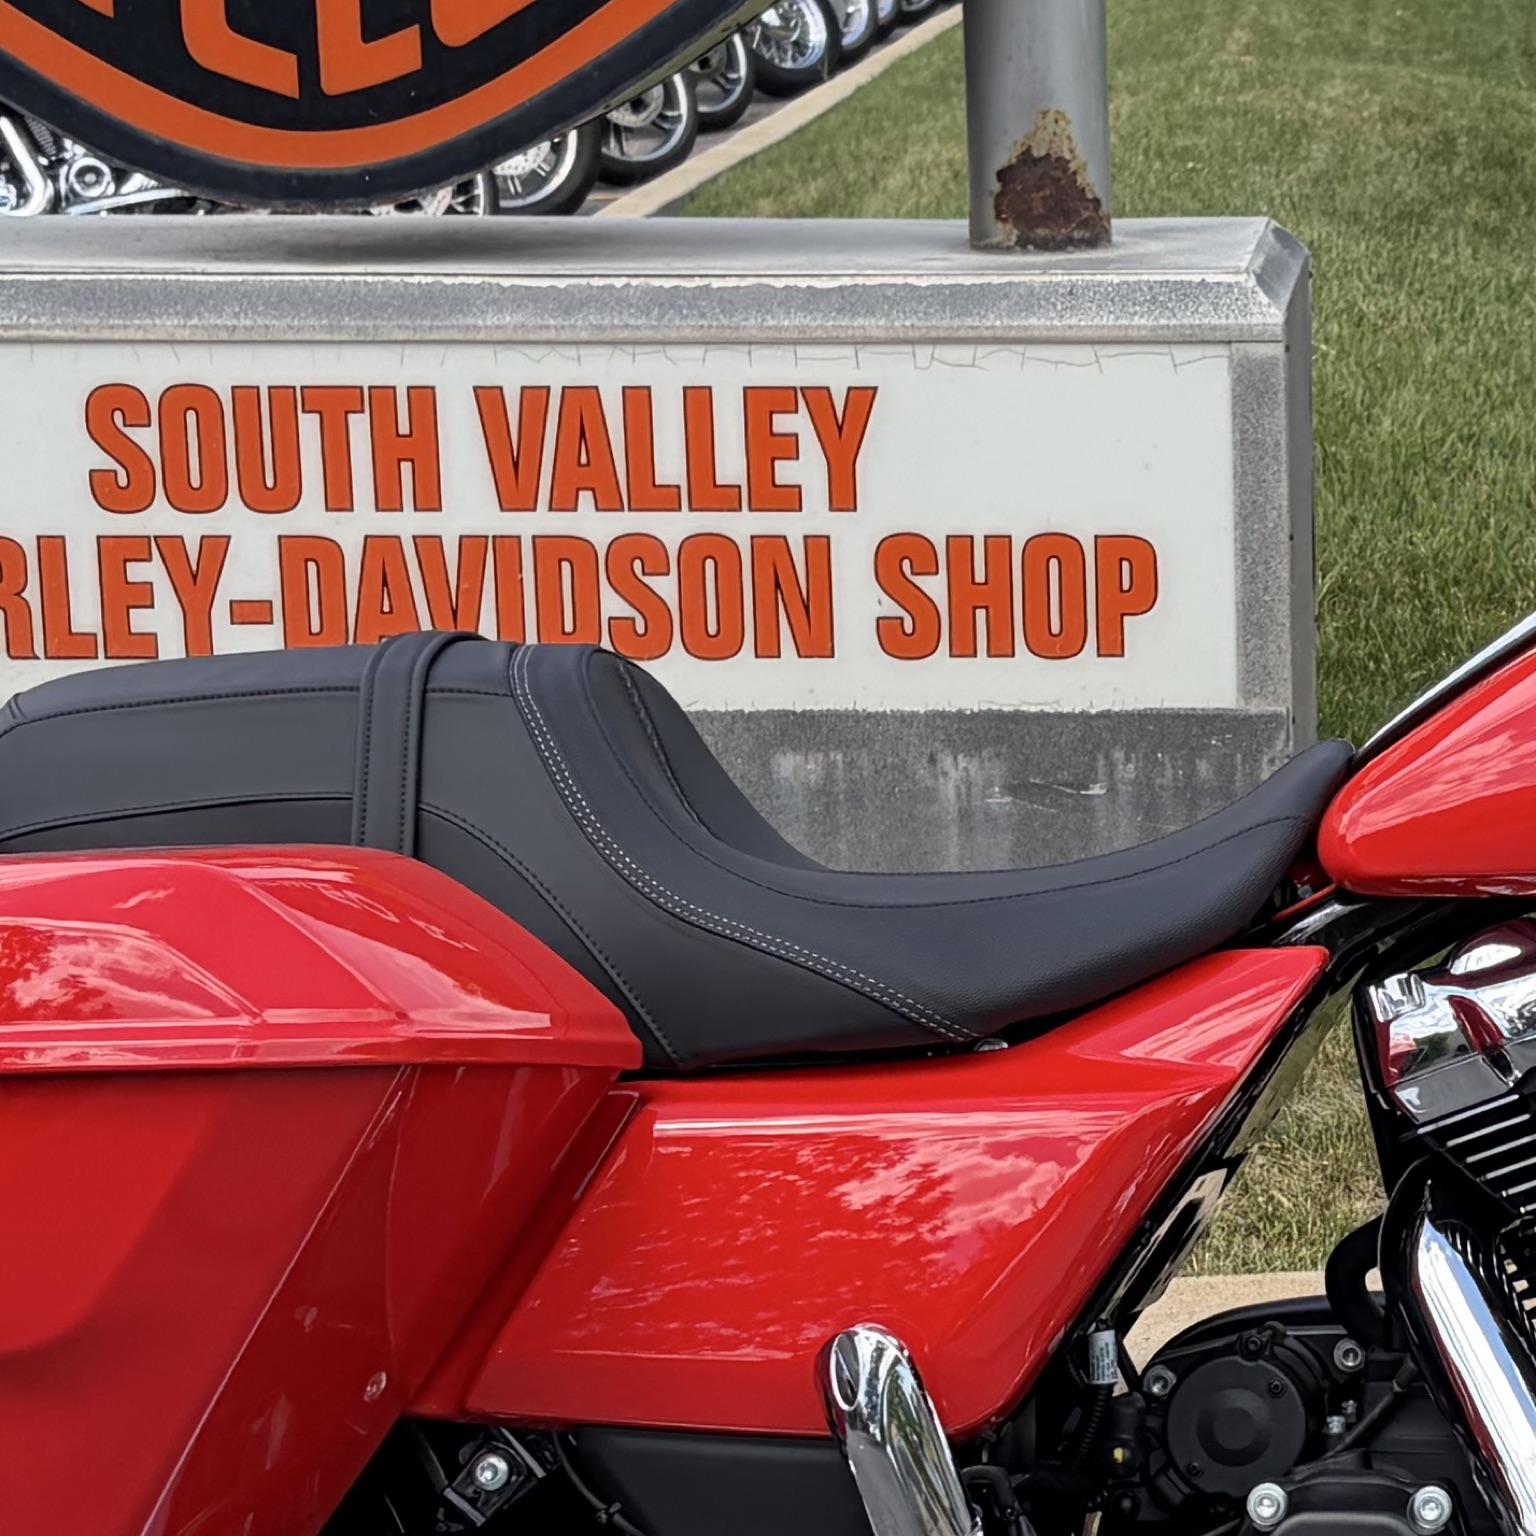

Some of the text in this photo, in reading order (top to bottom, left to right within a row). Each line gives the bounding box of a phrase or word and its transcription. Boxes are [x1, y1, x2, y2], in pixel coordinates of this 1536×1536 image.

[84, 383, 877, 514] SOUTH VALLEY
[875, 531, 1162, 661] SHOP
